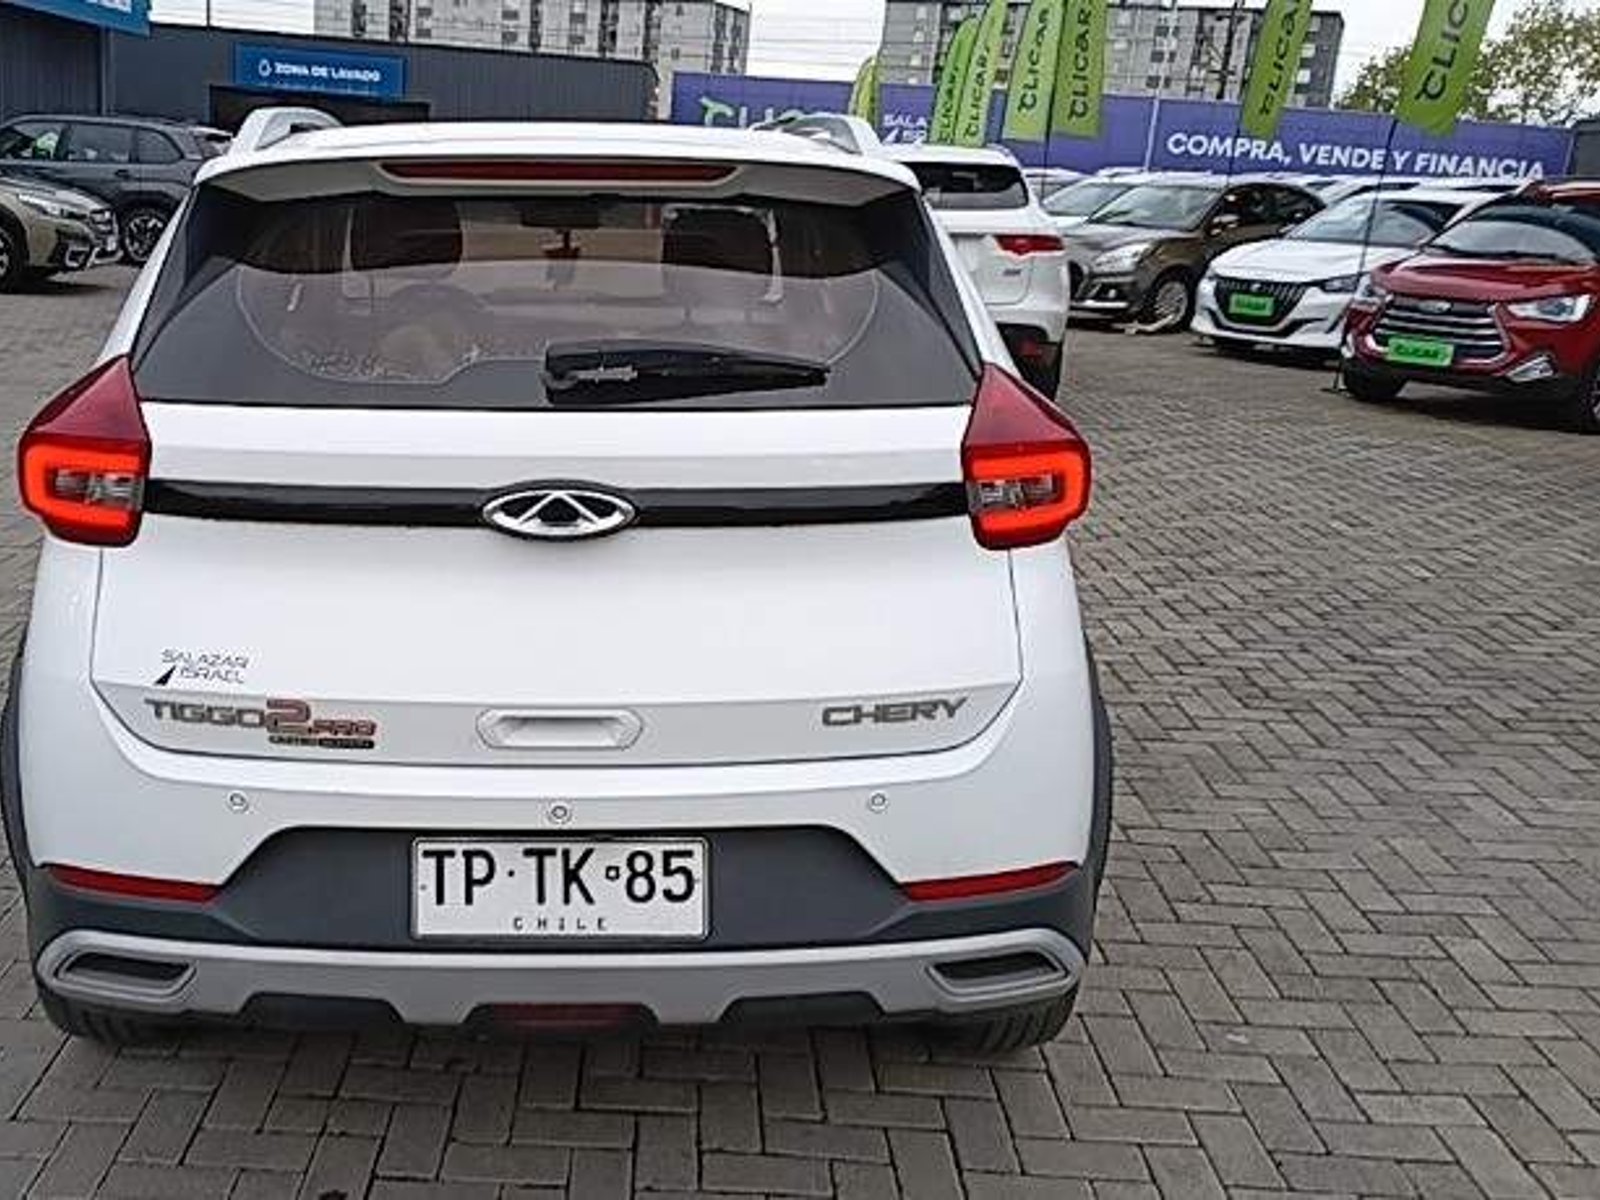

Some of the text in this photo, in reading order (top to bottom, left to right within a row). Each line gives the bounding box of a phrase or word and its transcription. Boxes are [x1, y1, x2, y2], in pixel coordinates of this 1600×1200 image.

[274, 62, 381, 82] ZONA DE LAVADO
[1017, 8, 1049, 112] CLICAR
[1067, 8, 1092, 121] CLICAR
[1259, 0, 1300, 115] CLICA
[1166, 132, 1544, 179] COMPRA, VENDE Y FINANCIA
[162, 648, 249, 669] SALAZAR
[180, 666, 245, 684] ISRAEL
[822, 696, 969, 726] CHERY
[513, 916, 607, 931] CHILE
